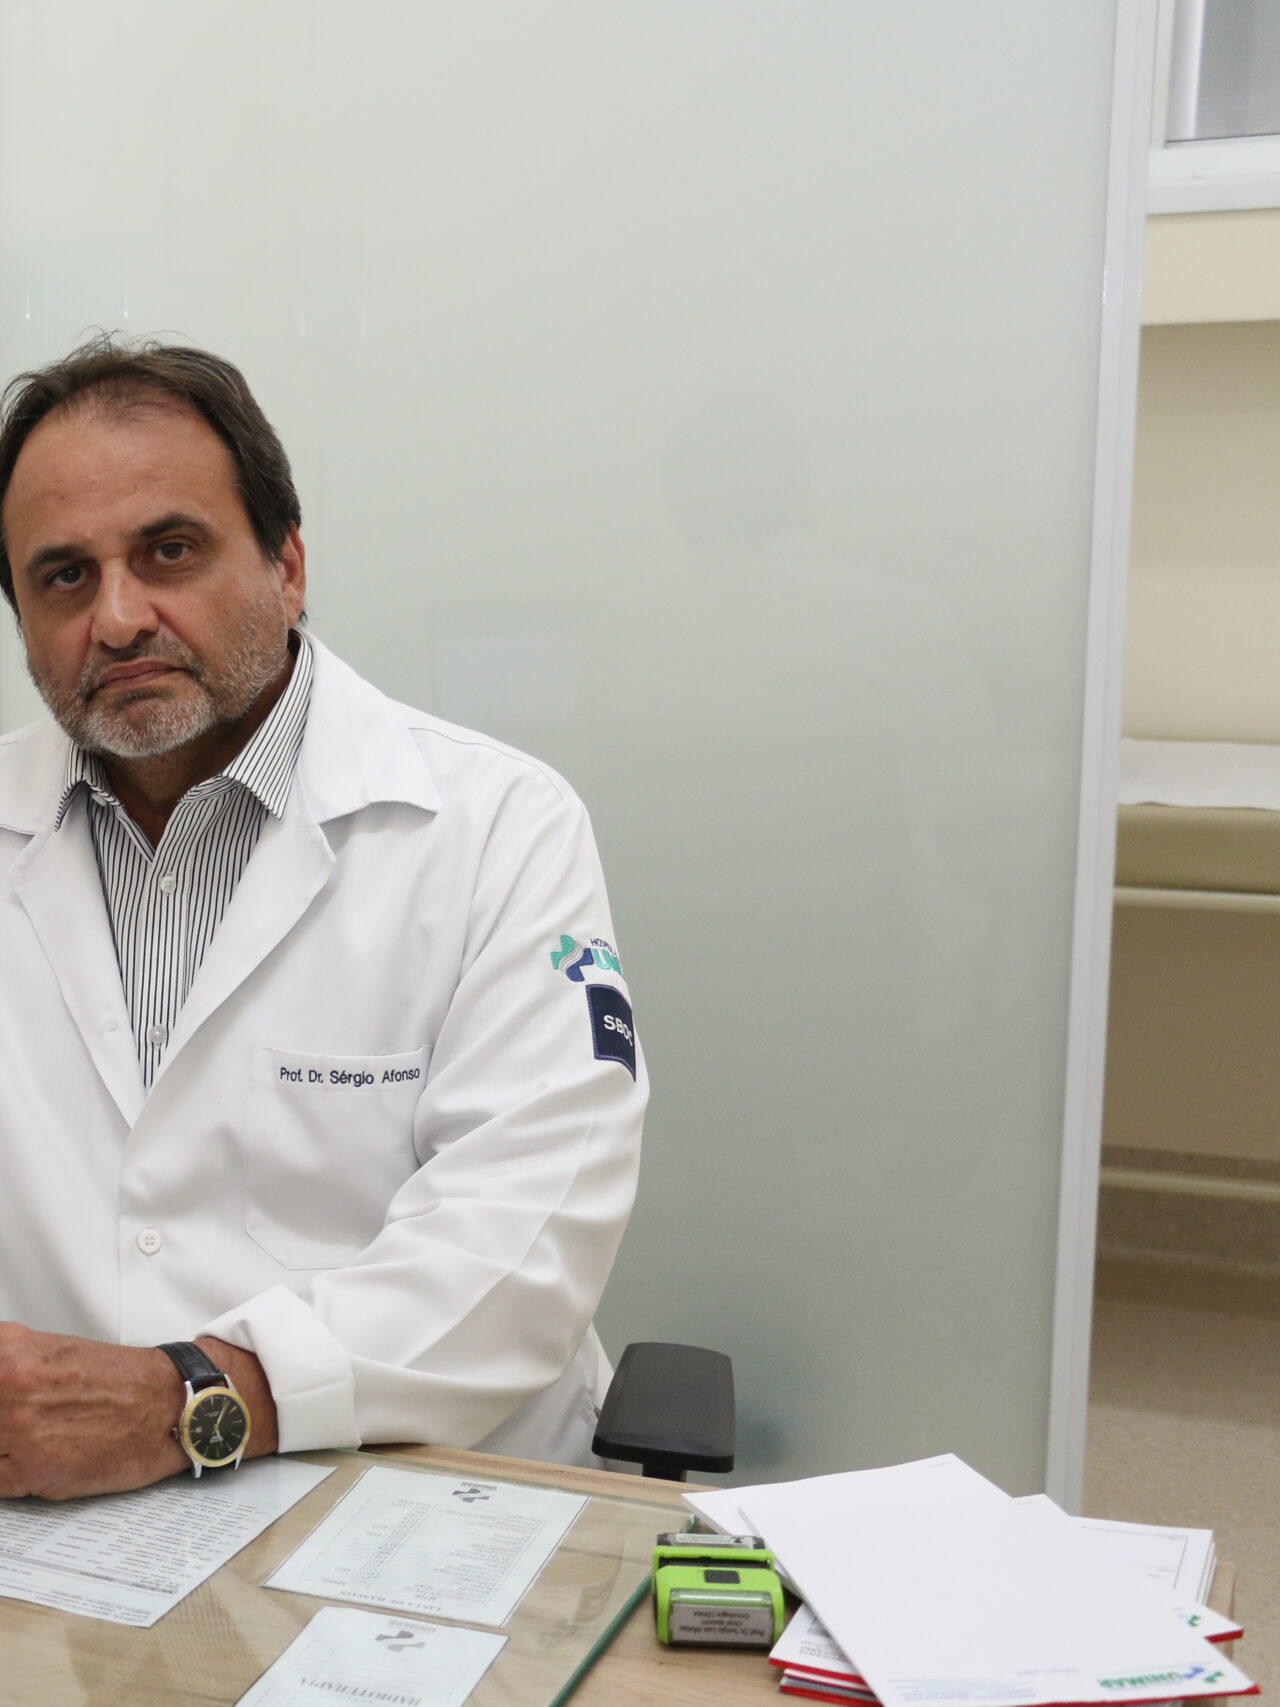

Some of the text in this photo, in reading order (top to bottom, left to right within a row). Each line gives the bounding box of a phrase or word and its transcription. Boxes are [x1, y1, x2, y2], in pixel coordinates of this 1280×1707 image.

[280, 1067, 420, 1087] Prof. Dr. Sérgio Afonso
[1097, 1671, 1183, 1688] UNIMAR
[300, 1677, 421, 1706] RADIOTERAPIA
